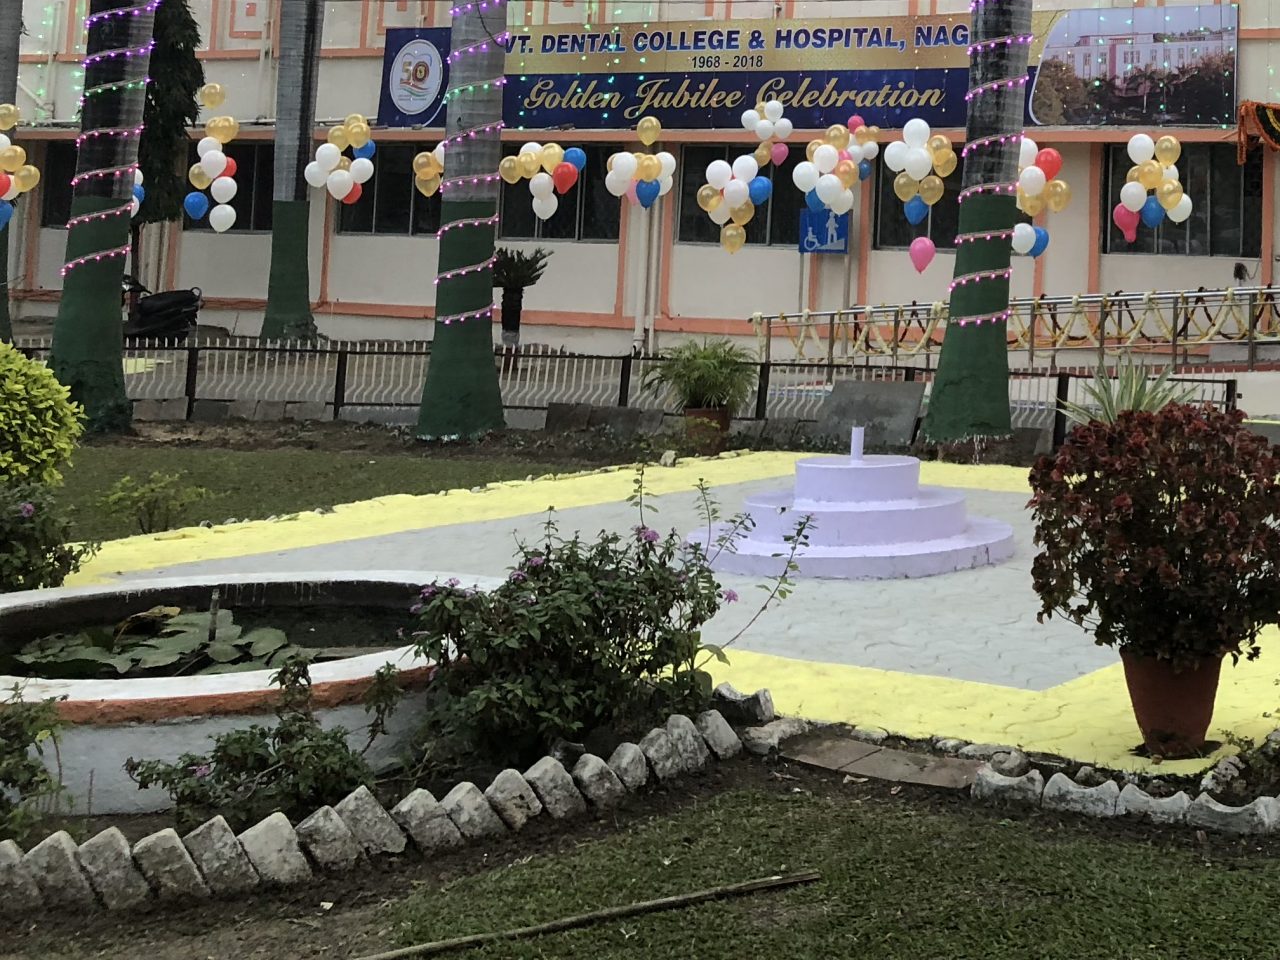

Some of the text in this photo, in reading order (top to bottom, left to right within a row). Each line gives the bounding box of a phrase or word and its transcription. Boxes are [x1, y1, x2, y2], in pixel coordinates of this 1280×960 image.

[540, 33, 626, 54] DENTAL
[633, 30, 741, 52] COLLEGE
[748, 29, 766, 50] &
[774, 26, 907, 52] HOSPITAL,
[691, 56, 721, 69] 1968
[733, 55, 763, 69] 2018
[523, 77, 947, 119] Golden Jubilee Celebration
